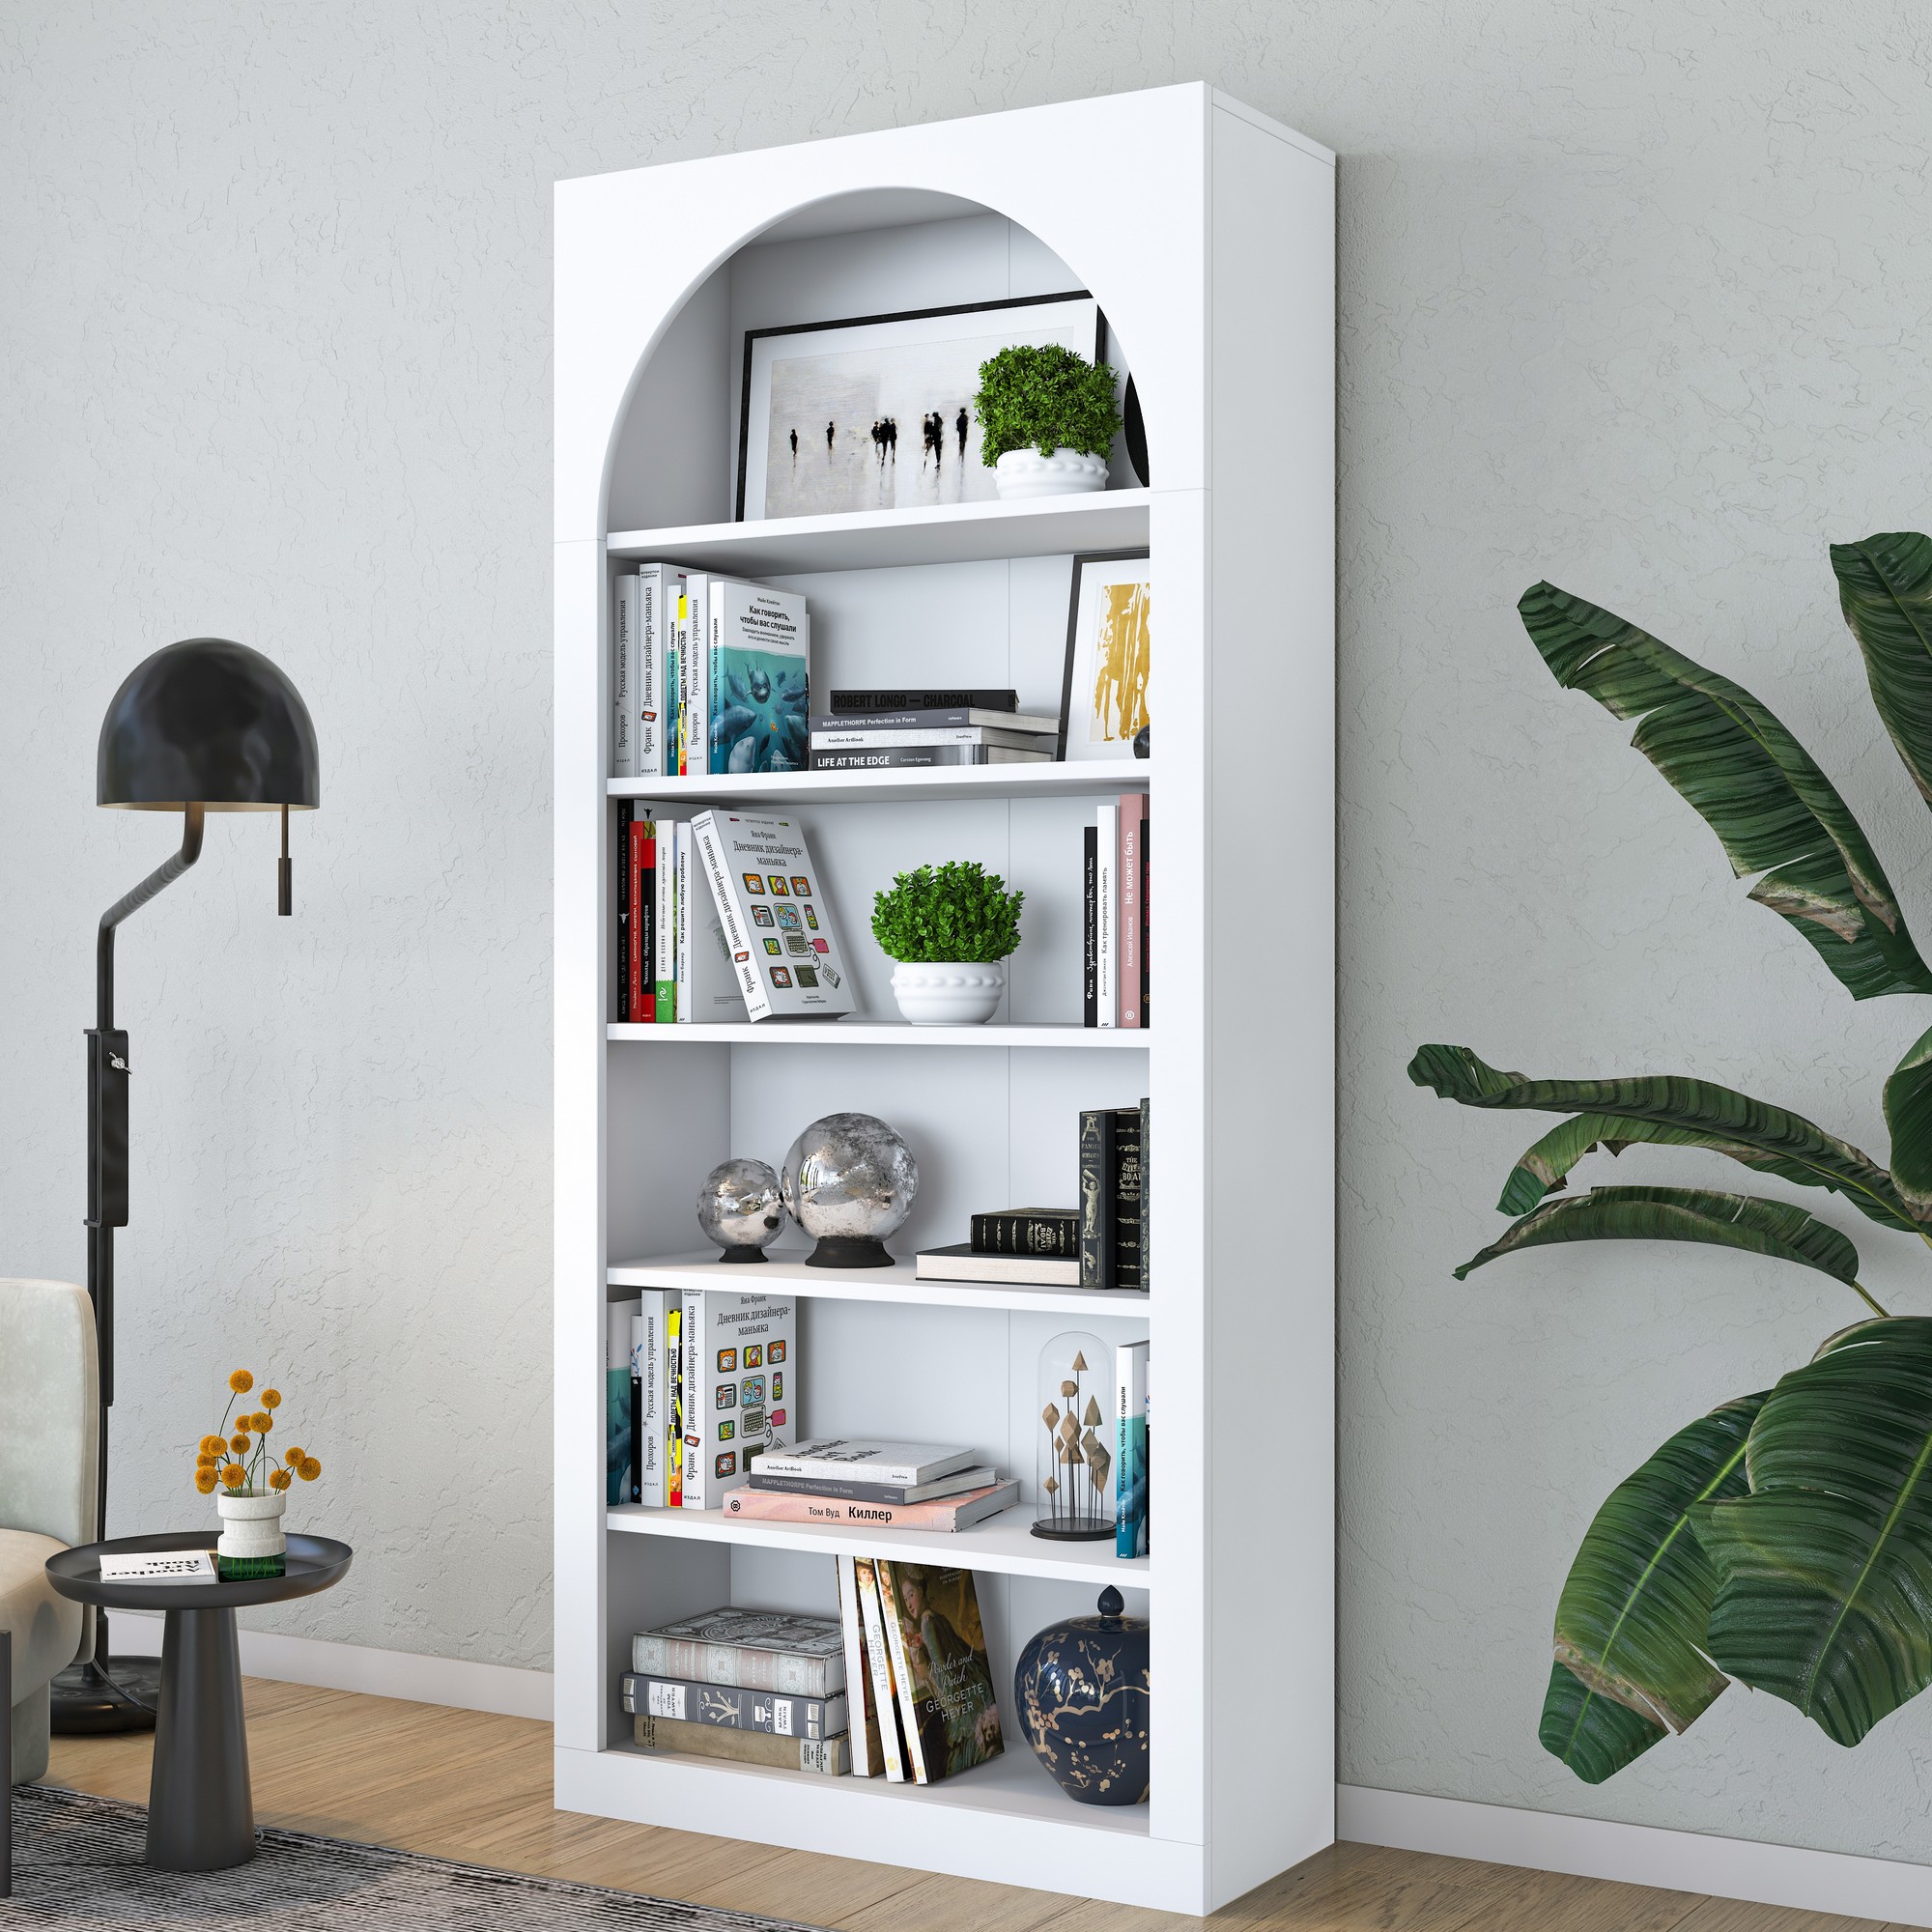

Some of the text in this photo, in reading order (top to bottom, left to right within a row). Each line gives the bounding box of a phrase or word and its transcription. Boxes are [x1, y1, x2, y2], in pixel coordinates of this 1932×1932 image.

[620, 600, 628, 642] управления
[693, 599, 701, 641] управления
[740, 616, 759, 626] чтобы
[770, 622, 797, 632] слушали
[749, 605, 790, 621] Как говорить,
[618, 670, 628, 698] Русская
[644, 587, 654, 754] Франк Дневник дизайнера-маньяка
[692, 669, 701, 696] Русская
[834, 694, 975, 708] ROBERT LONGO CHARCOAL
[618, 714, 628, 748] Прохоров
[691, 713, 701, 745] Прохоров
[818, 756, 890, 767] LIFE AT THE EDGE
[733, 841, 803, 858] Дневник дизайнера-
[760, 831, 777, 840] Франк
[1124, 832, 1133, 855] быть
[757, 857, 787, 867] маньяка
[1125, 892, 1133, 904] Не
[703, 835, 756, 994] Франк Дневник дизайнера-маньяка
[750, 1295, 766, 1305] Франк
[717, 1306, 791, 1326] Дневник дизайнера-
[738, 1324, 769, 1336] маньяка
[648, 1317, 656, 1361] управления
[647, 1390, 656, 1418] Русская
[687, 1305, 697, 1480] Франк Дневник дизайнера-маньяка
[646, 1436, 656, 1470] Прохоров
[762, 1478, 804, 1488] MAPPLETHORPE
[805, 1483, 832, 1492] Perfection
[808, 1506, 892, 1523] Том Вуд Киллер
[868, 1639, 879, 1678] HEYER
[873, 1624, 889, 1691] GEORGETTE
[890, 1622, 909, 1702] GEORGETTE HEYER
[928, 1644, 974, 1681] Powder and
[938, 1664, 968, 1697] Patch
[926, 1683, 984, 1713] GEORGETTE
[941, 1701, 974, 1722] HEYER
